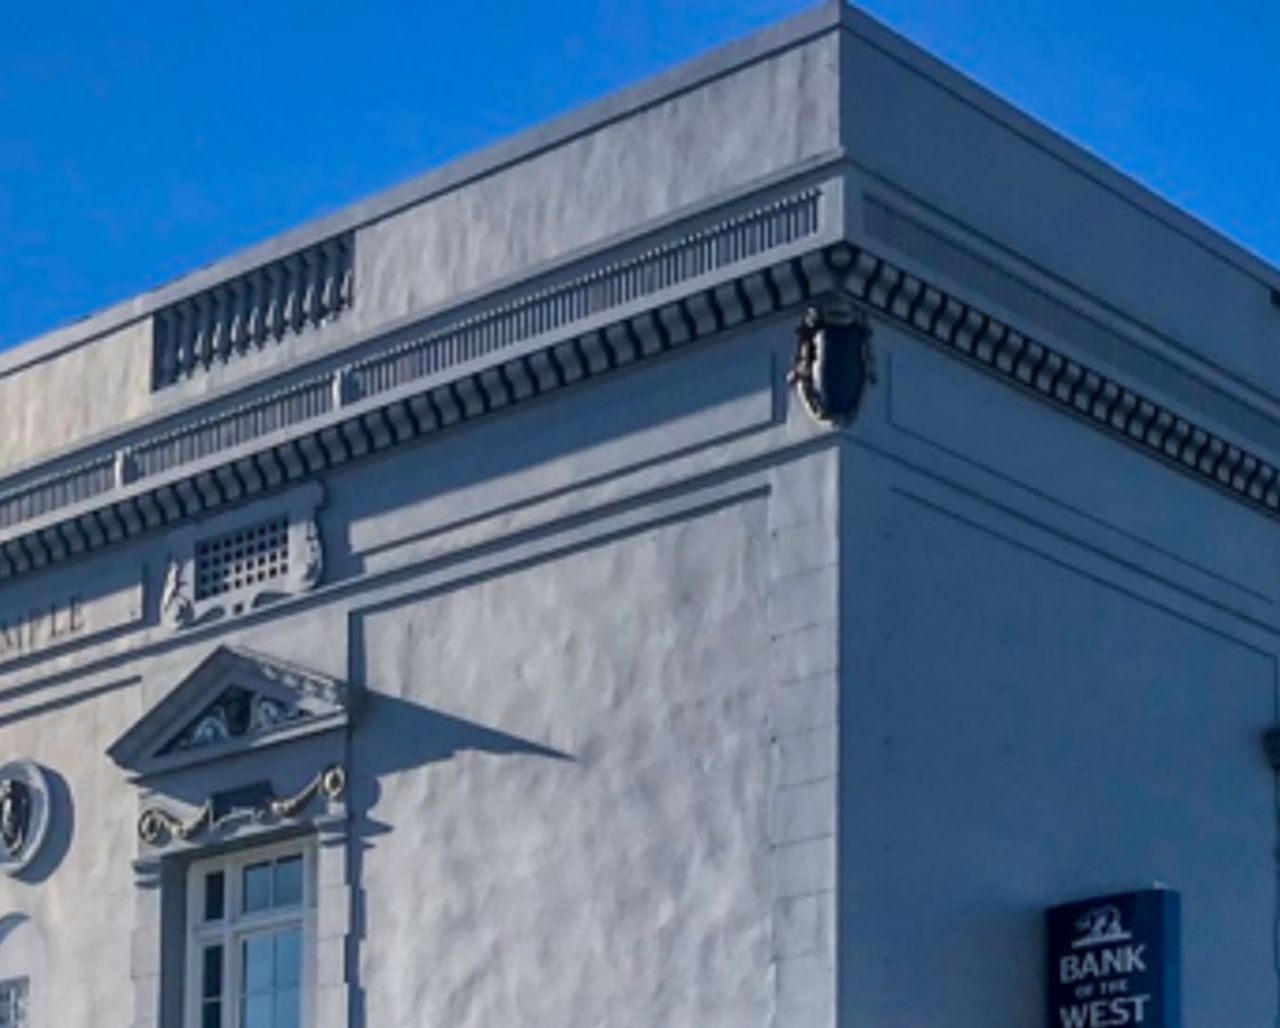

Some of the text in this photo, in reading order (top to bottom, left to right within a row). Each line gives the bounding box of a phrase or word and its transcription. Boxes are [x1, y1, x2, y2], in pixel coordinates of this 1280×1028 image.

[1059, 944, 1147, 985] BANK
[1074, 979, 1129, 998] OF THE
